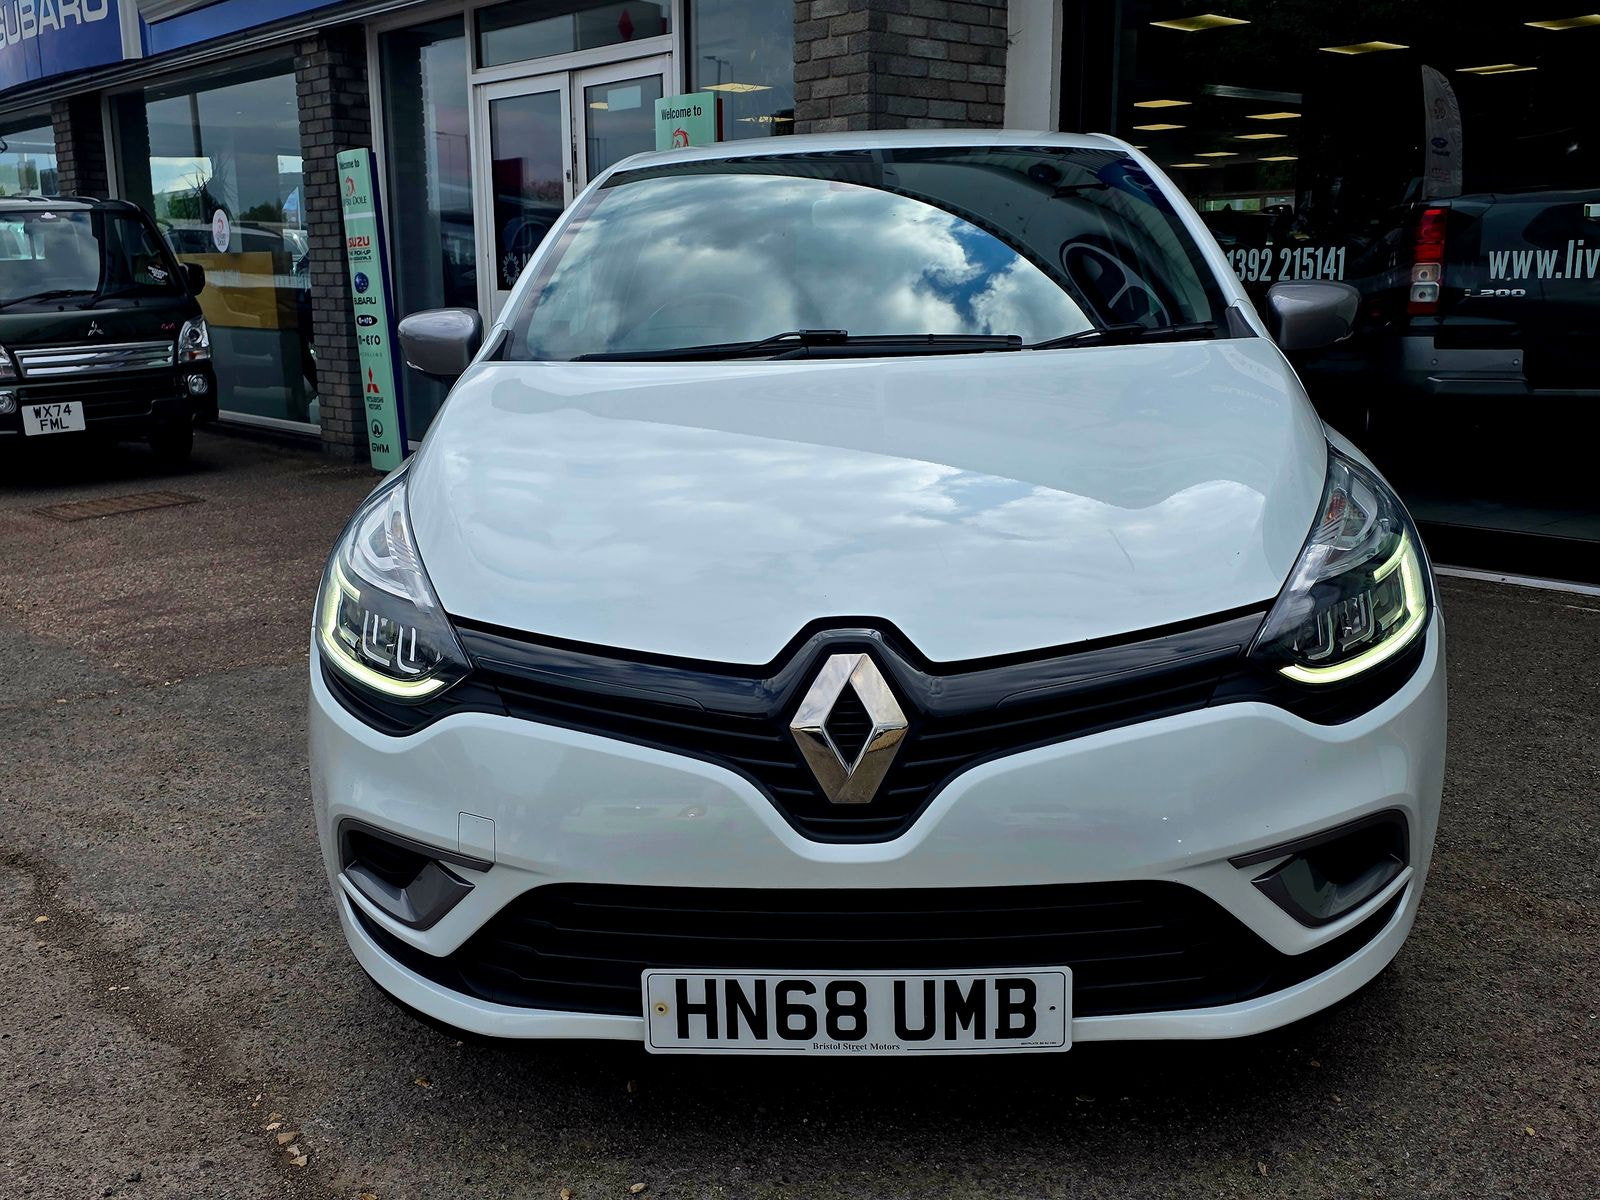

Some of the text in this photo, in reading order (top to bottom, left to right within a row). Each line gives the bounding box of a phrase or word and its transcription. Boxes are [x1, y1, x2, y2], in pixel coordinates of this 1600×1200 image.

[661, 105, 702, 120] Welcome to
[1278, 246, 1346, 281] 215141
[1489, 240, 1600, 279] www.liv
[33, 404, 72, 418] WX74
[40, 417, 69, 431] FML
[372, 442, 390, 454] GWM
[675, 977, 1037, 1041] HN68 UMB
